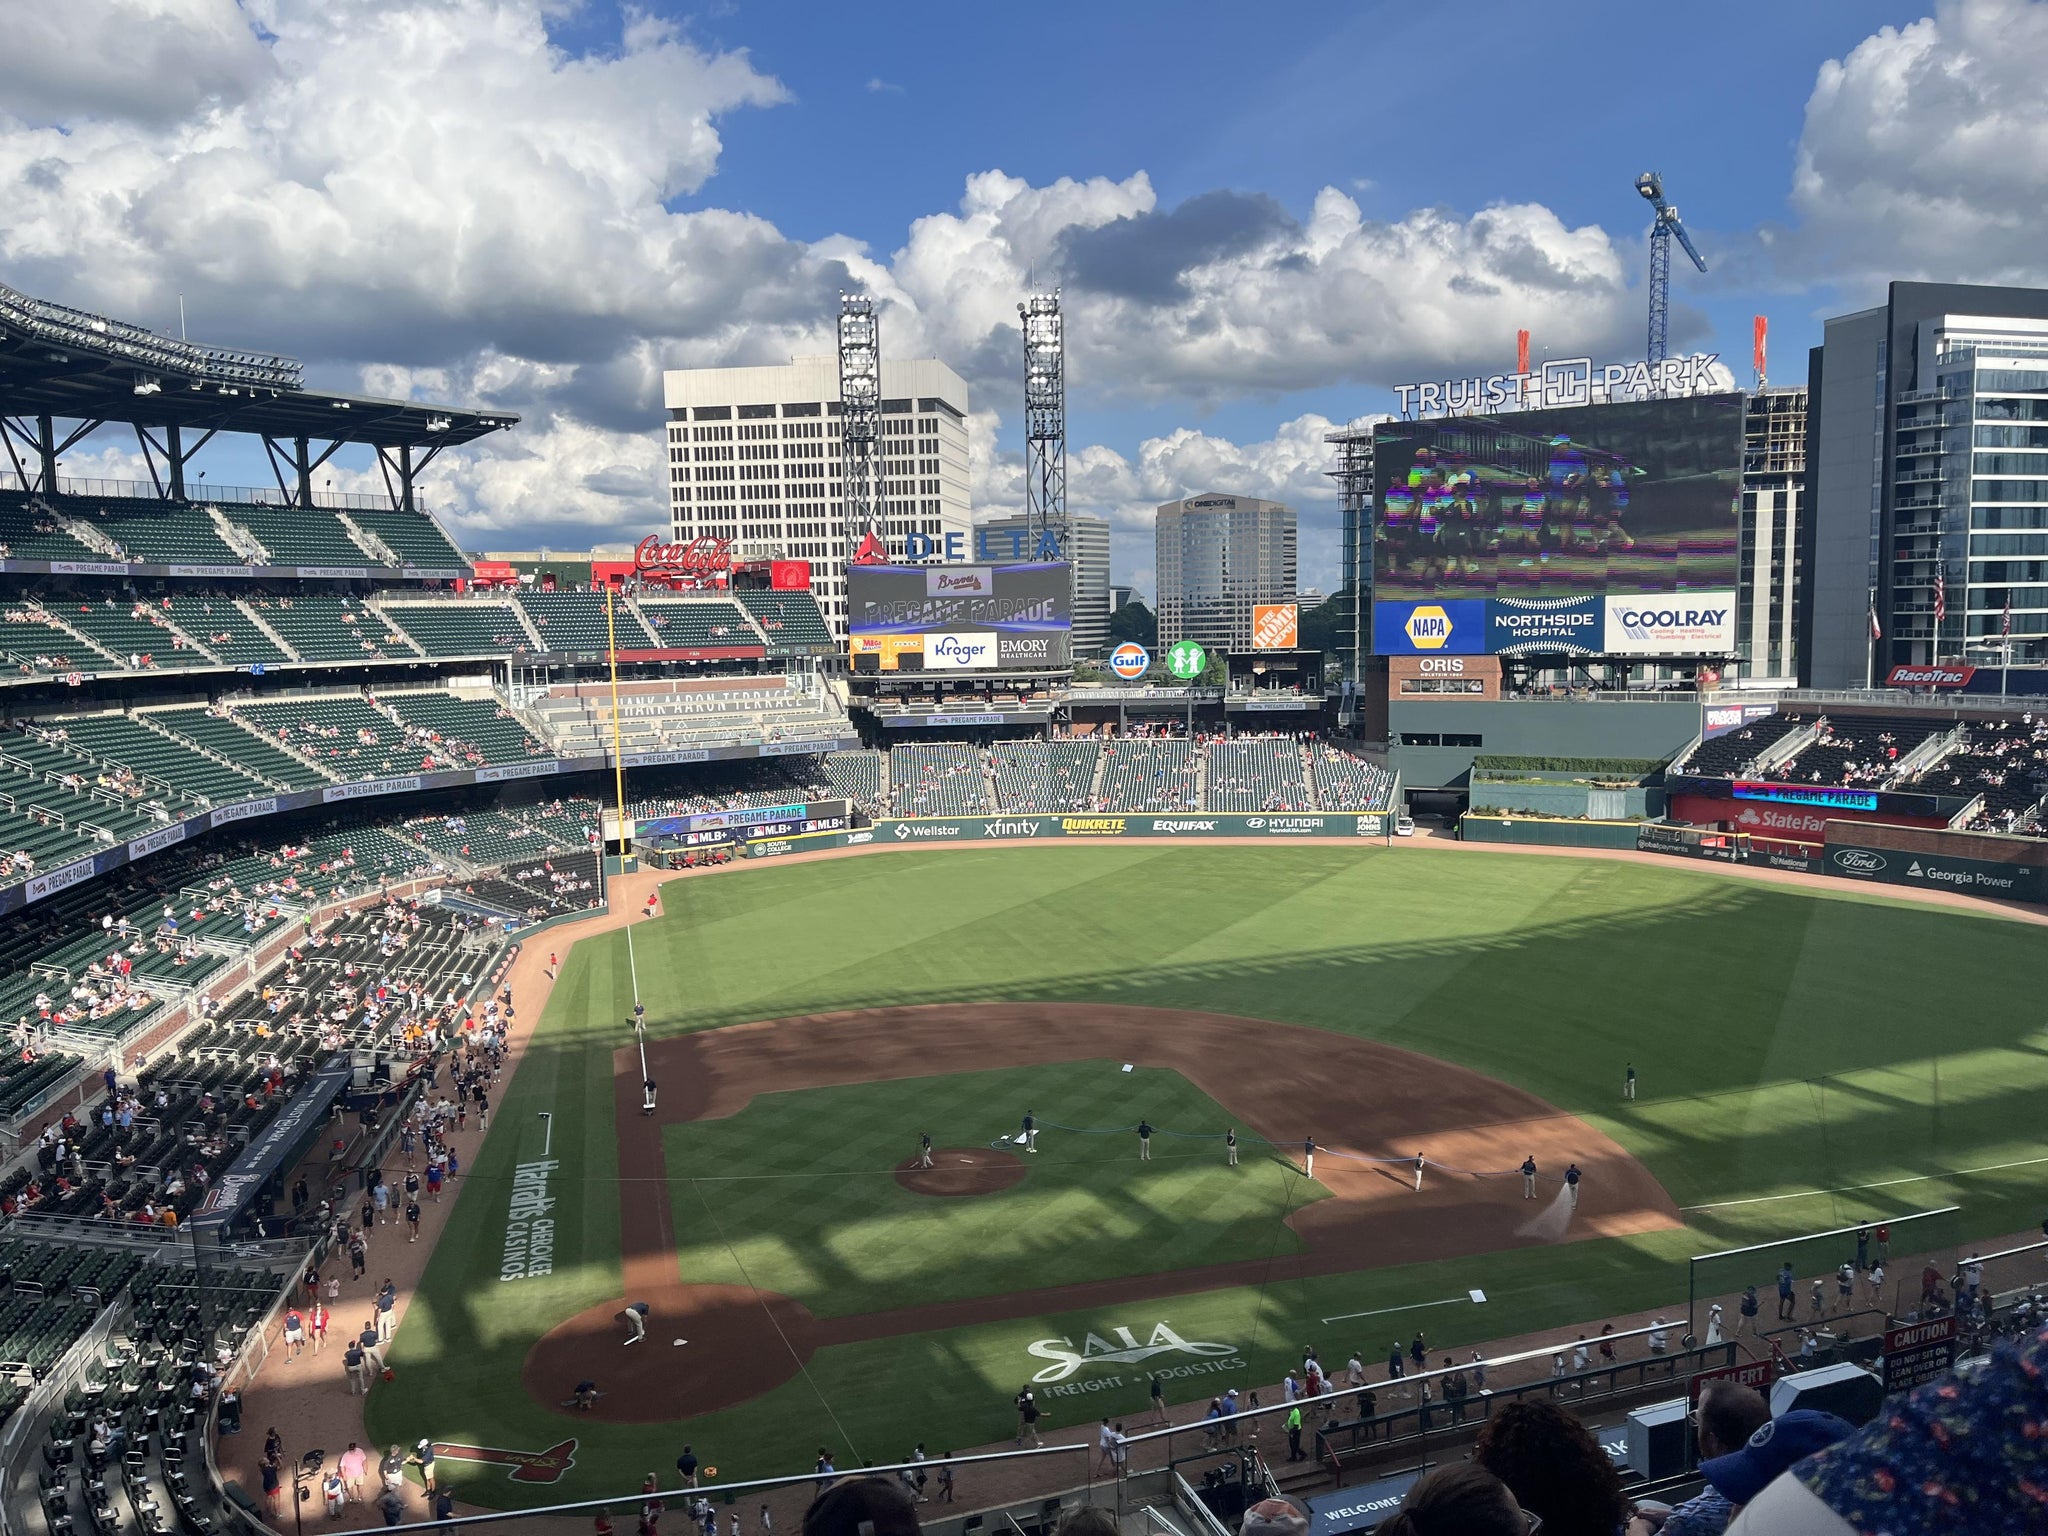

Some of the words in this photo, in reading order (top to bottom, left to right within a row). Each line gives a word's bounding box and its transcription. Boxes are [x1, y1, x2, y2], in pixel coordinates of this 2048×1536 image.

[1394, 373, 1532, 413] TRUIST
[1603, 353, 1720, 394] PARK
[907, 530, 1061, 560] DELTA
[76, 563, 102, 573] PREGAME
[103, 564, 126, 574] PARADE
[196, 566, 225, 576] PREGAME
[226, 567, 250, 576] PARADE
[938, 574, 976, 590] Braves
[865, 600, 964, 625] PREGAME
[971, 597, 1055, 624] PARADE
[1258, 609, 1276, 627] THE
[1622, 609, 1728, 628] COOLRAY
[1254, 605, 1297, 647] HOME
[1413, 618, 1445, 636] NAPA
[1495, 614, 1595, 627] NORTHSIDE
[1270, 620, 1297, 647] DEPOT
[1513, 628, 1576, 637] HOSPITAL
[935, 636, 986, 664] Kroger
[1001, 639, 1049, 652] EMORY
[1113, 655, 1145, 666] Gulf
[1420, 659, 1464, 672] ORIS
[67, 673, 81, 686] 47
[1893, 669, 1963, 682] RaceTrac
[665, 693, 725, 714] AARON
[951, 715, 977, 723] PREGAME
[978, 715, 1000, 723] PARADE
[784, 744, 811, 753] PREGAME
[812, 742, 836, 751] PARADE
[643, 753, 677, 764] PREGAME
[678, 751, 706, 761] PARADE
[502, 766, 531, 777] PREGAME
[532, 763, 556, 774] PARADE
[347, 783, 385, 796] PREGAME
[386, 780, 417, 791] PARADE
[249, 801, 274, 813] PARADE
[1829, 792, 1871, 807] PARADE
[728, 811, 768, 824] PREGAME
[770, 807, 802, 821] PARADE
[1269, 819, 1324, 828] HYUNDAI
[1762, 811, 1800, 829] State
[1801, 815, 1826, 832] Far
[765, 825, 792, 836] MLB+
[818, 820, 844, 831] MLB+
[912, 825, 960, 837] Wellstar
[984, 819, 1040, 838] xfinity
[1062, 818, 1127, 831] QUIKRETE
[1153, 820, 1216, 834] EQUIFAX
[1356, 823, 1382, 831] JOHNS
[147, 835, 167, 851] PREGAME
[167, 828, 184, 843] PARADE
[700, 832, 727, 843] MLB+
[767, 845, 792, 853] COLLEGE
[1778, 857, 1808, 868] National
[1842, 852, 1877, 869] Ford
[48, 870, 73, 890] PREGAME
[73, 862, 92, 881] PARADE
[1927, 867, 1972, 885] Georgia
[1976, 873, 2013, 888] Power
[508, 1159, 560, 1220] Harrah's
[500, 1221, 529, 1281] CASINOS
[528, 1219, 555, 1277] CHEROKEE
[1893, 1321, 1949, 1347] CAUTION
[1027, 1321, 1230, 1383] SAIA
[1891, 1359, 1902, 1368] DO
[1904, 1353, 1921, 1364] NOT
[1922, 1349, 1935, 1360] SIT
[1891, 1367, 1912, 1379] LEAN
[1913, 1360, 1934, 1373] OVER
[1935, 1357, 1948, 1366] OR
[1042, 1376, 1123, 1399] FREIGHT
[1146, 1357, 1248, 1381] LOGISTICS
[1889, 1378, 1913, 1390] PLACE
[1324, 1496, 1402, 1521] WELCOME
